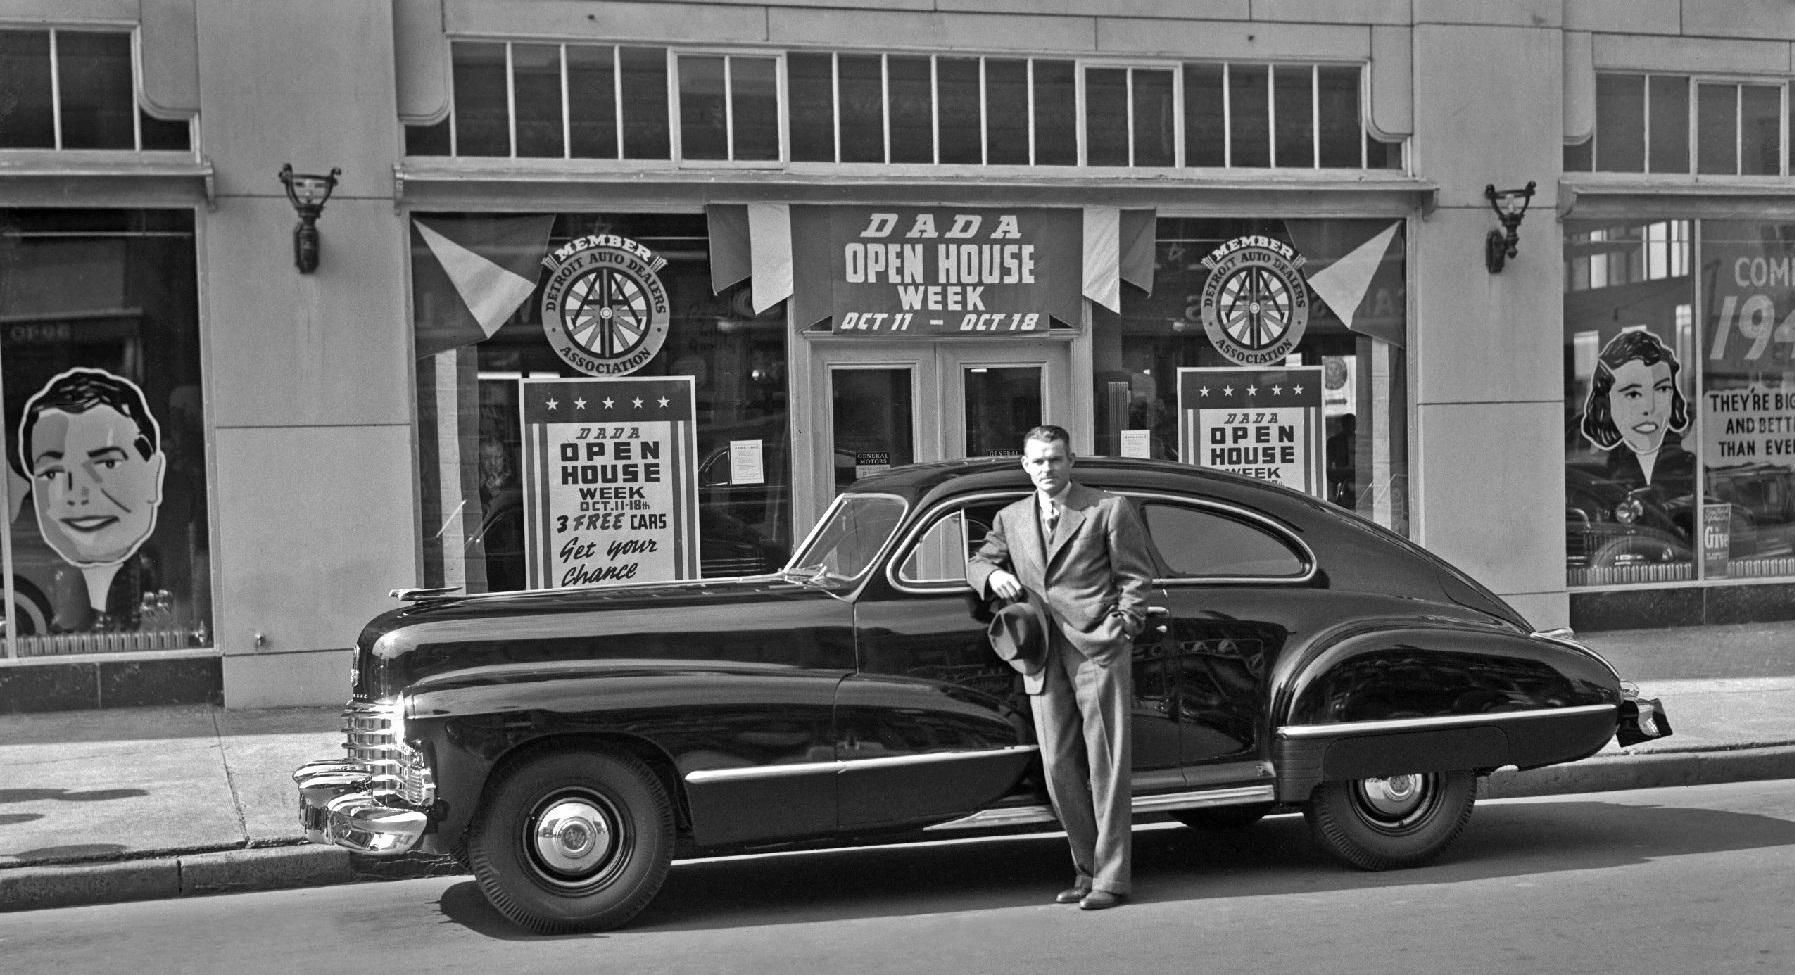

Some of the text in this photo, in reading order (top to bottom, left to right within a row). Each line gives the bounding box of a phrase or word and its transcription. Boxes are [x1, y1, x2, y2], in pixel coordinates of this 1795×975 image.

[859, 212, 1022, 239] DADA
[554, 234, 652, 262] MEMBER
[1211, 234, 1294, 261] MEMBER
[844, 243, 1036, 284] OPEN HOUSE
[1734, 256, 1795, 288] COM
[545, 251, 666, 314] DETROIT AUTO DEALERS
[1203, 257, 1237, 308] DETROIT
[1241, 251, 1271, 263] AUTO
[1273, 256, 1306, 308] DEALERS
[896, 285, 986, 311] WEEK
[840, 312, 889, 330] OCT
[890, 312, 912, 330] 11
[959, 312, 1008, 330] OCT
[1009, 312, 1039, 330] 18
[559, 346, 653, 374] ASSOCIATION
[1214, 338, 1294, 364] ASSOCIATION
[1709, 386, 1769, 412] THEY'RE
[1223, 412, 1279, 424] DADA
[1725, 416, 1795, 434] AND BETT
[576, 427, 640, 440] DADA
[1210, 424, 1295, 445] OPEN
[560, 441, 660, 462] OPEN
[1210, 446, 1295, 466] HOUSE
[1718, 438, 1795, 457] THAN EVE
[561, 463, 660, 485] HOUSE
[579, 486, 645, 500] WEEK
[556, 512, 667, 534] 3 FREE CARS
[560, 536, 657, 563] Get your
[561, 563, 638, 588] Chance
